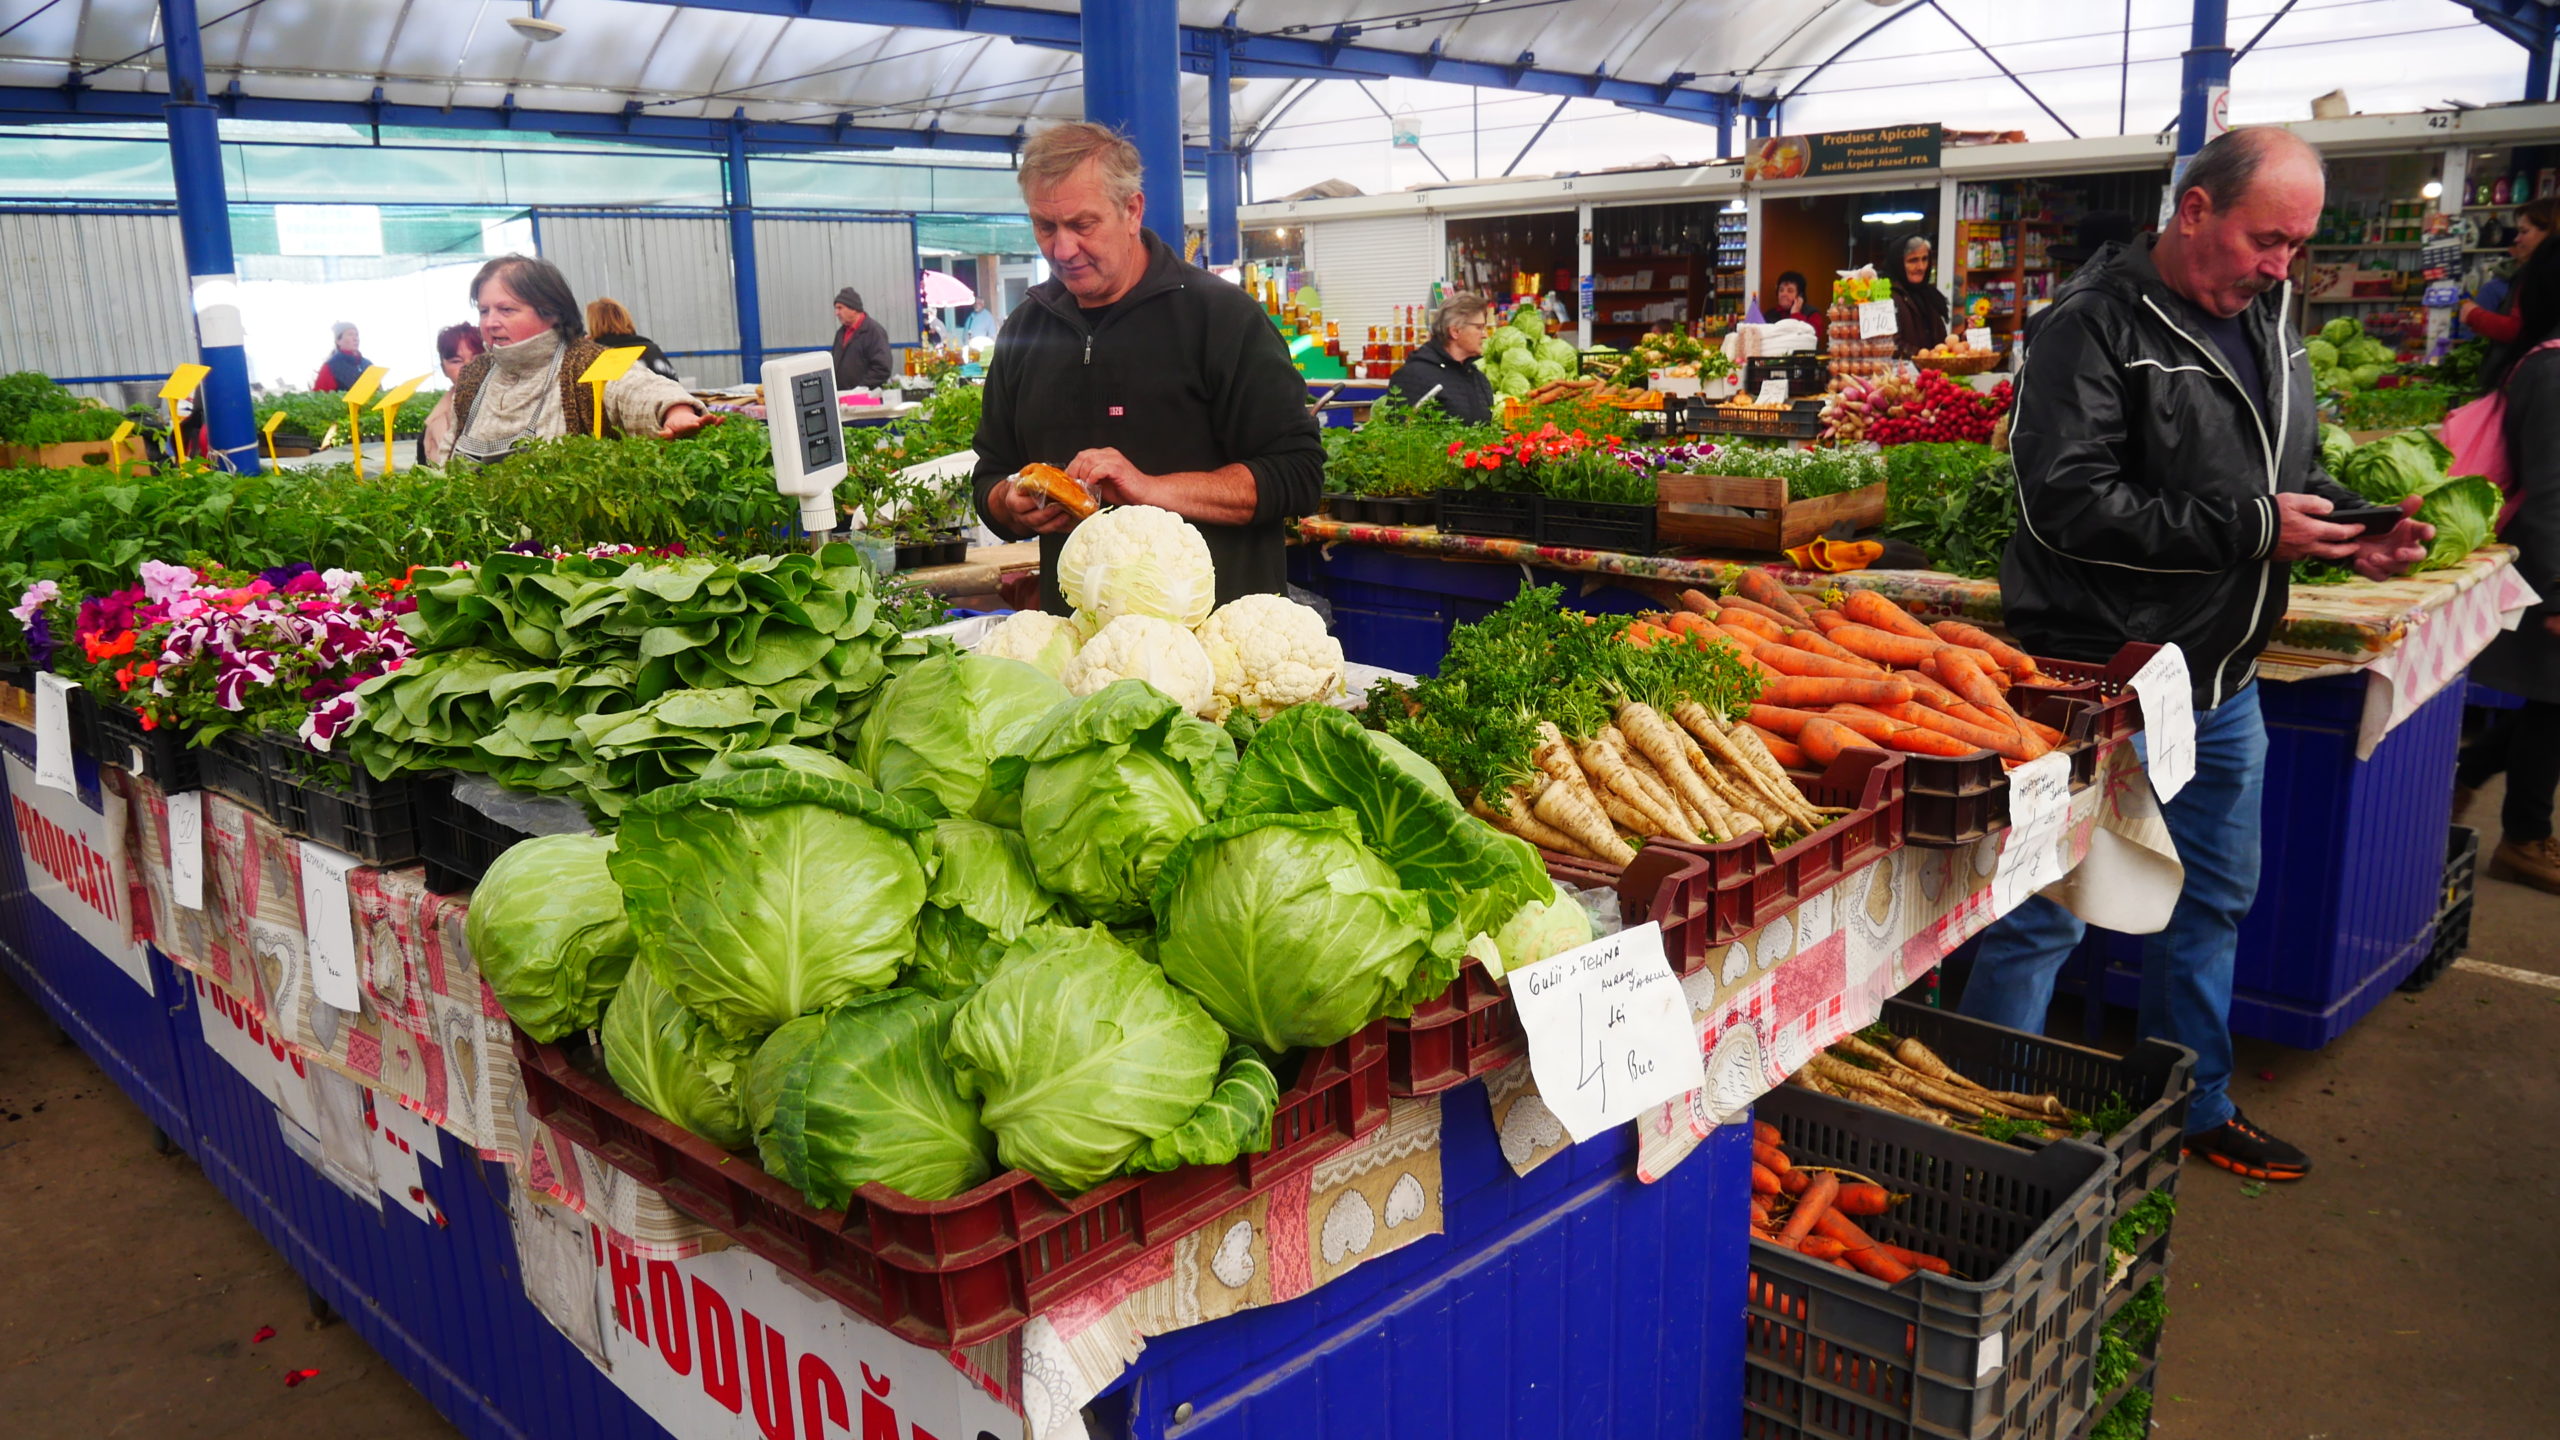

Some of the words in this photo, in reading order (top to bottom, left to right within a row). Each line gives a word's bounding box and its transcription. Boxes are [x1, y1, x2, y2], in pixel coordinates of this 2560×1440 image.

[2428, 116, 2448, 128] 42
[1822, 130, 1875, 146] Produse
[1879, 126, 1930, 144] Apicole
[2155, 135, 2170, 145] 41
[1910, 154, 1928, 165] PFA
[1729, 168, 1742, 178] 39
[1562, 181, 1573, 191] 38
[1417, 194, 1426, 204] 37
[2159, 695, 2176, 779] 4
[12, 792, 120, 924] PRODUCĂT
[1576, 992, 1606, 1114] 4
